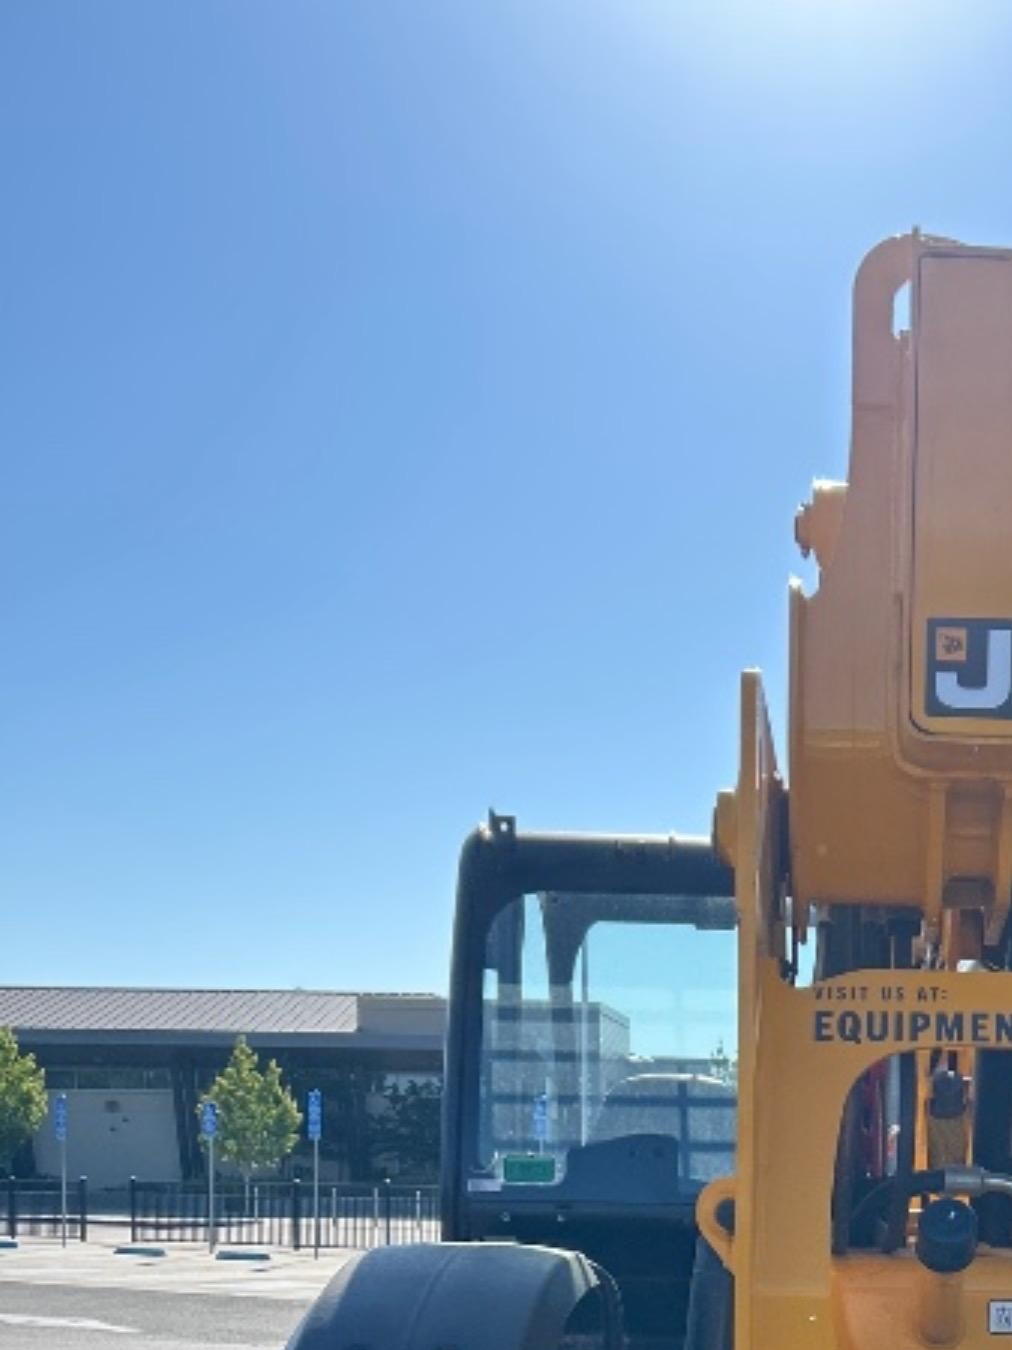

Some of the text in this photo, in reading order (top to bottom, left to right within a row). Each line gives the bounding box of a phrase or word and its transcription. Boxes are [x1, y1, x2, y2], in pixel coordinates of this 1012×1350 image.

[814, 987, 948, 1001] VISIT US AT:
